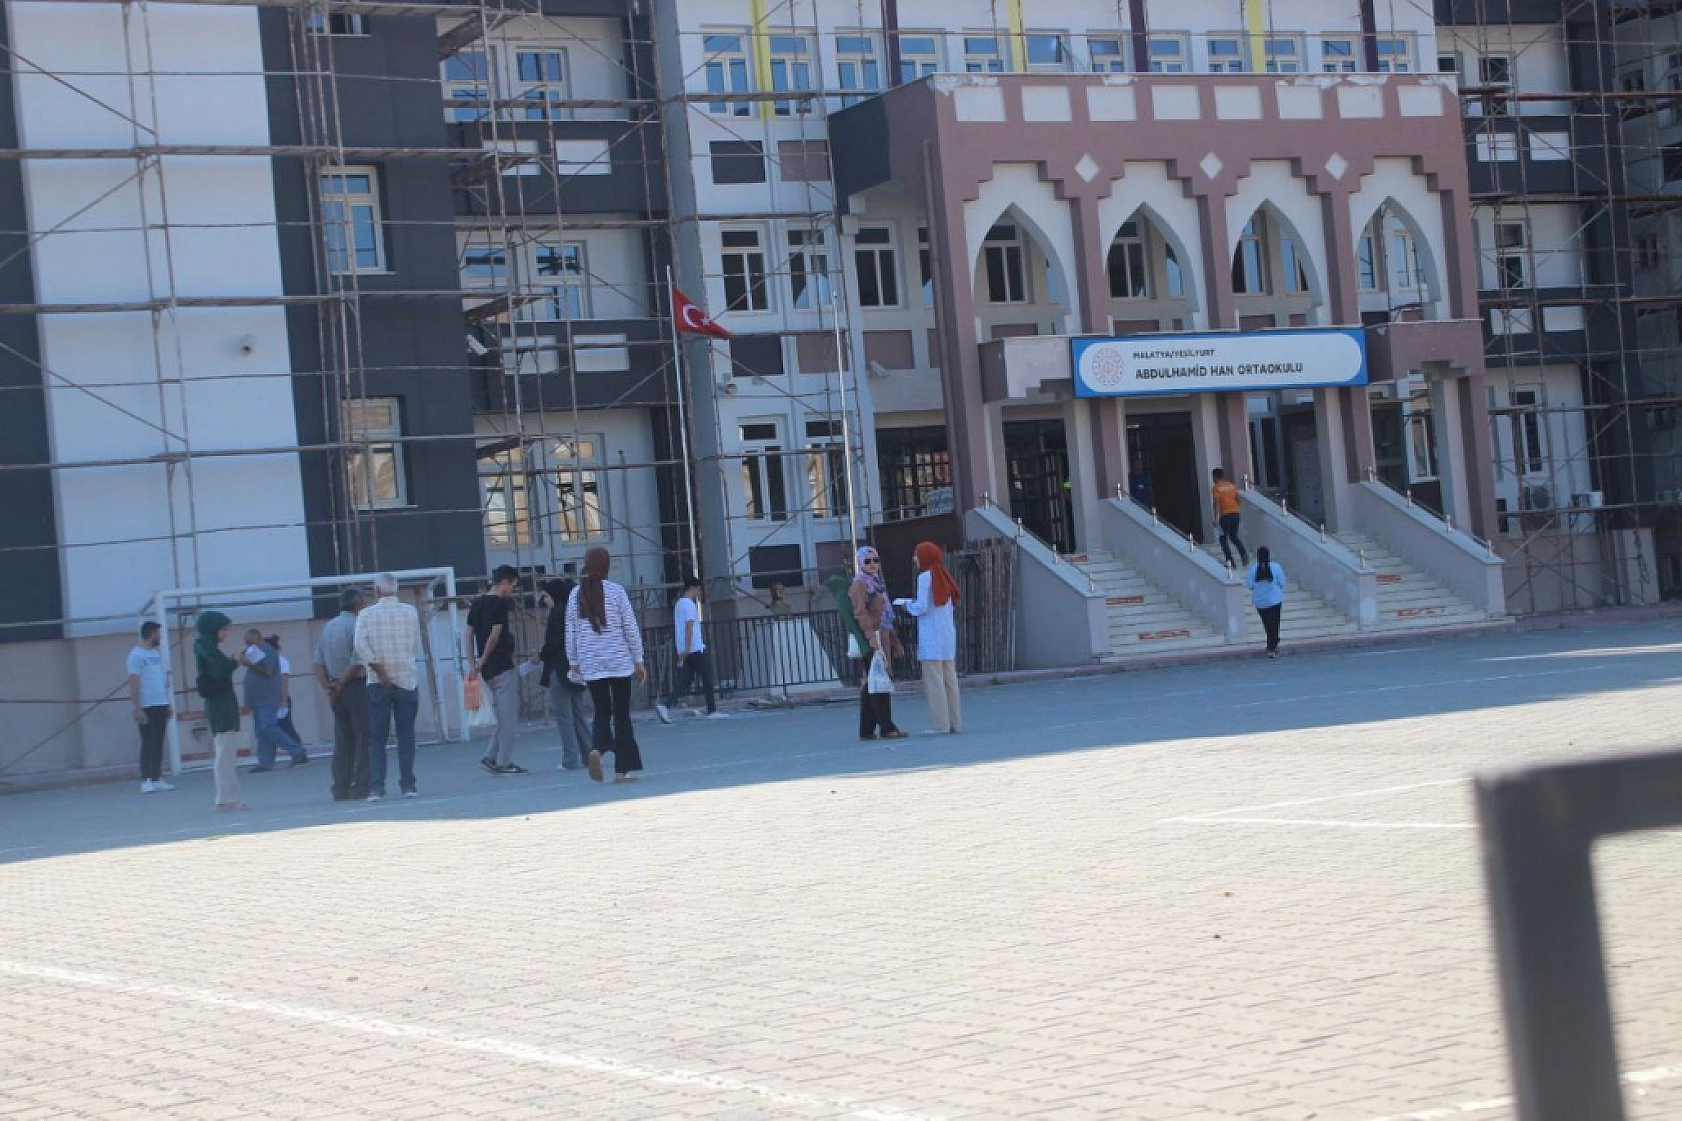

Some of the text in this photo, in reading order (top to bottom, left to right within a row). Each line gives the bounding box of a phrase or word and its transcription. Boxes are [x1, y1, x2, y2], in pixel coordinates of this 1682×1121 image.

[1135, 362, 1304, 379] ABDULHAMİD HAN ORTAOKULU
